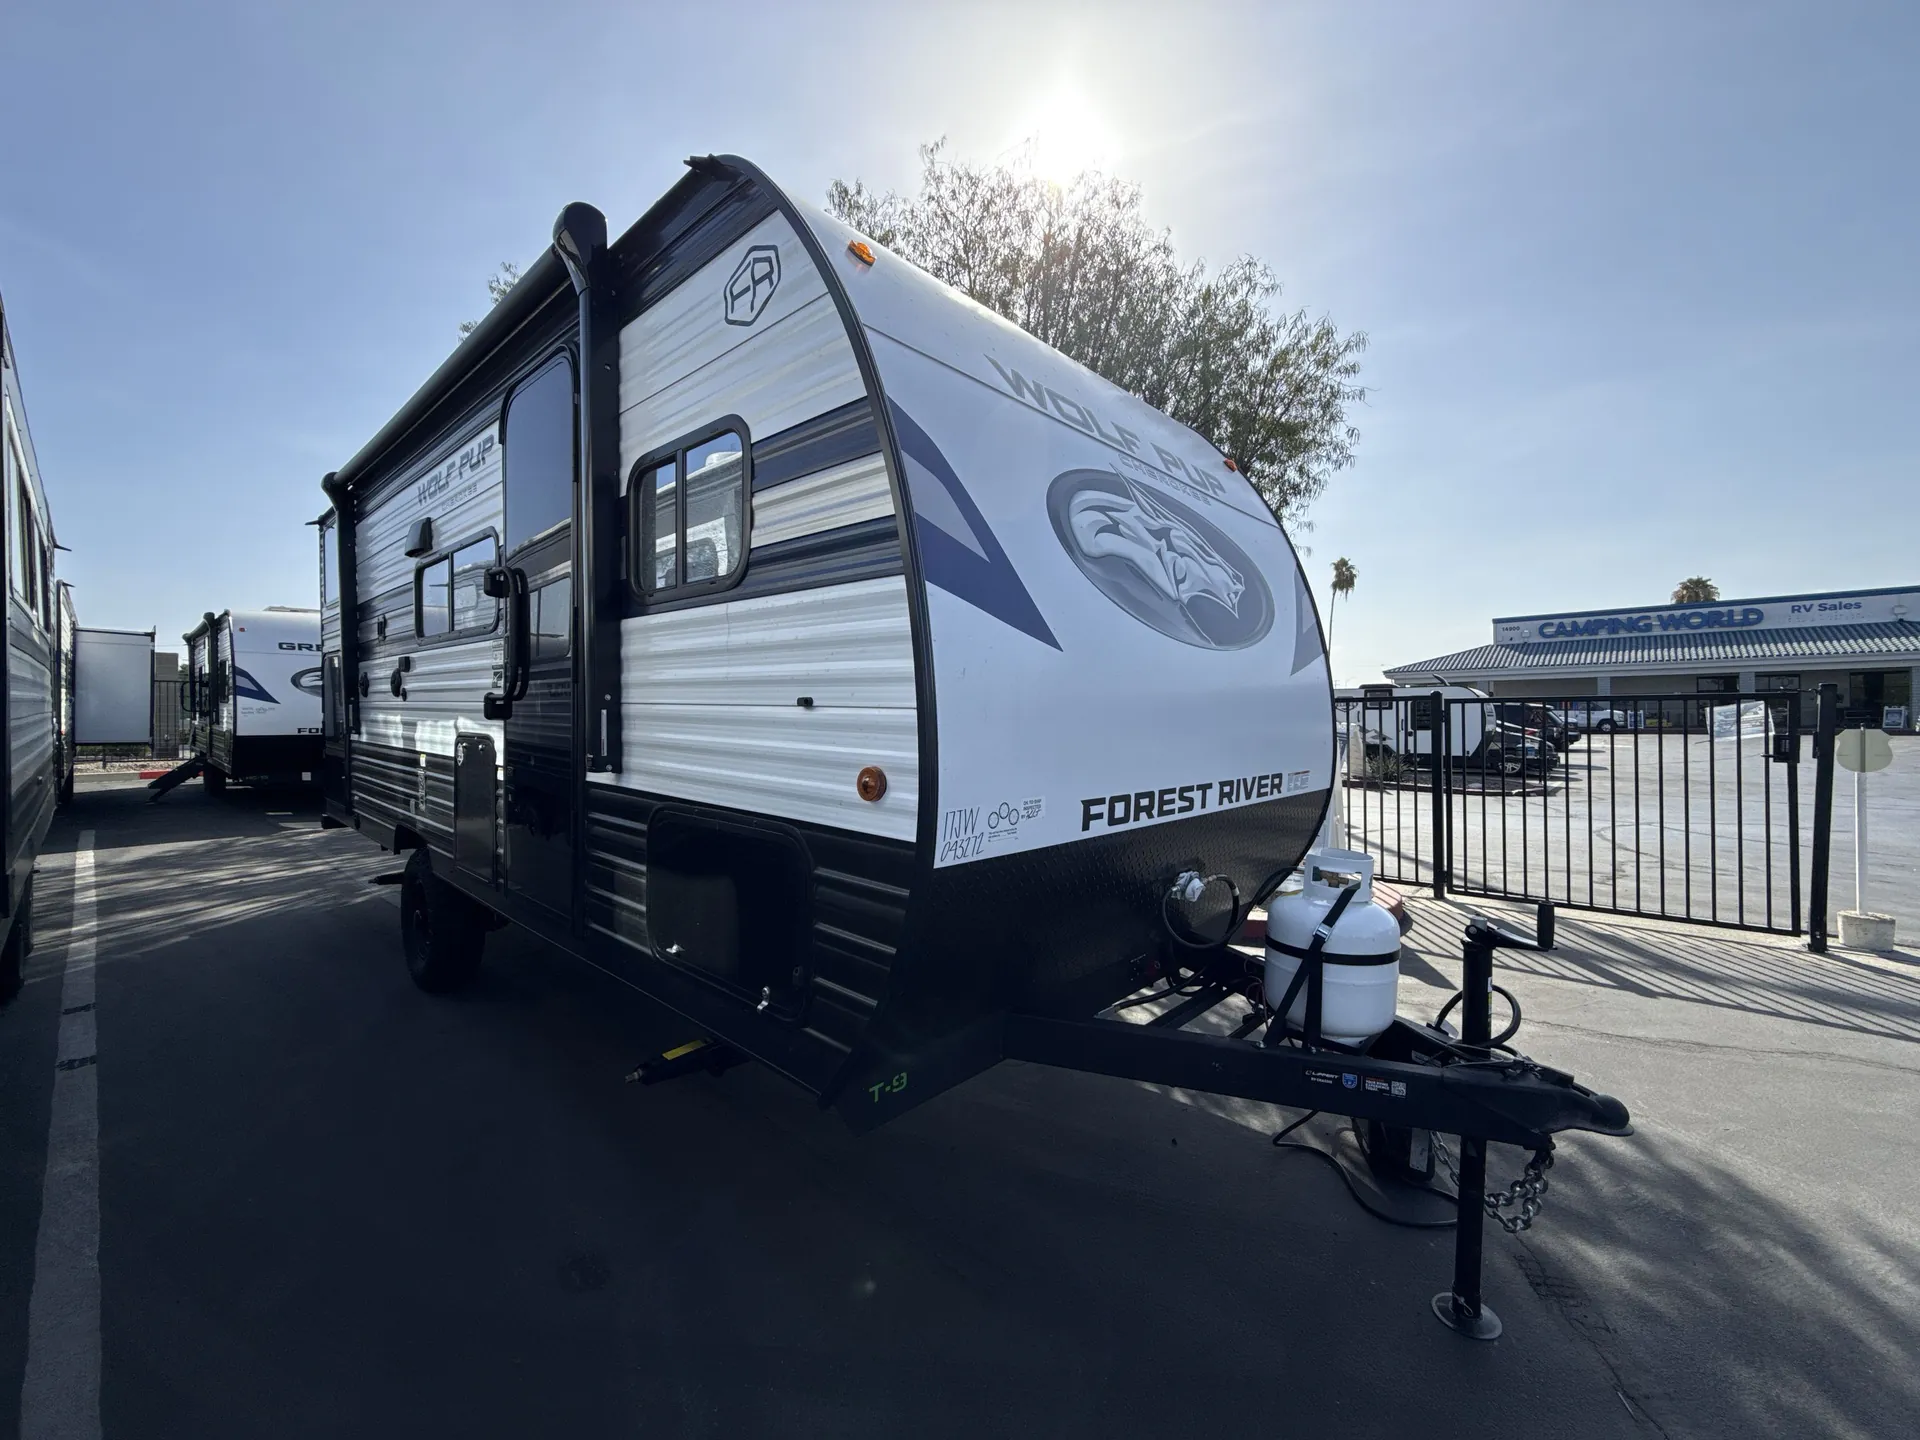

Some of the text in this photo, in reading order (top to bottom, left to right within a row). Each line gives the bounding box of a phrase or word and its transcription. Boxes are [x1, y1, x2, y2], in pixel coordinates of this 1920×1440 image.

[982, 353, 1227, 497] WOLF PUP
[417, 434, 494, 506] WOLF PUP
[1117, 452, 1212, 506] CHEROKEE
[1538, 607, 1764, 638] CAMPING WORLD
[1791, 601, 1862, 614] RV Sales
[1080, 782, 1213, 832] FOREST
[1218, 772, 1283, 806] RIVER
